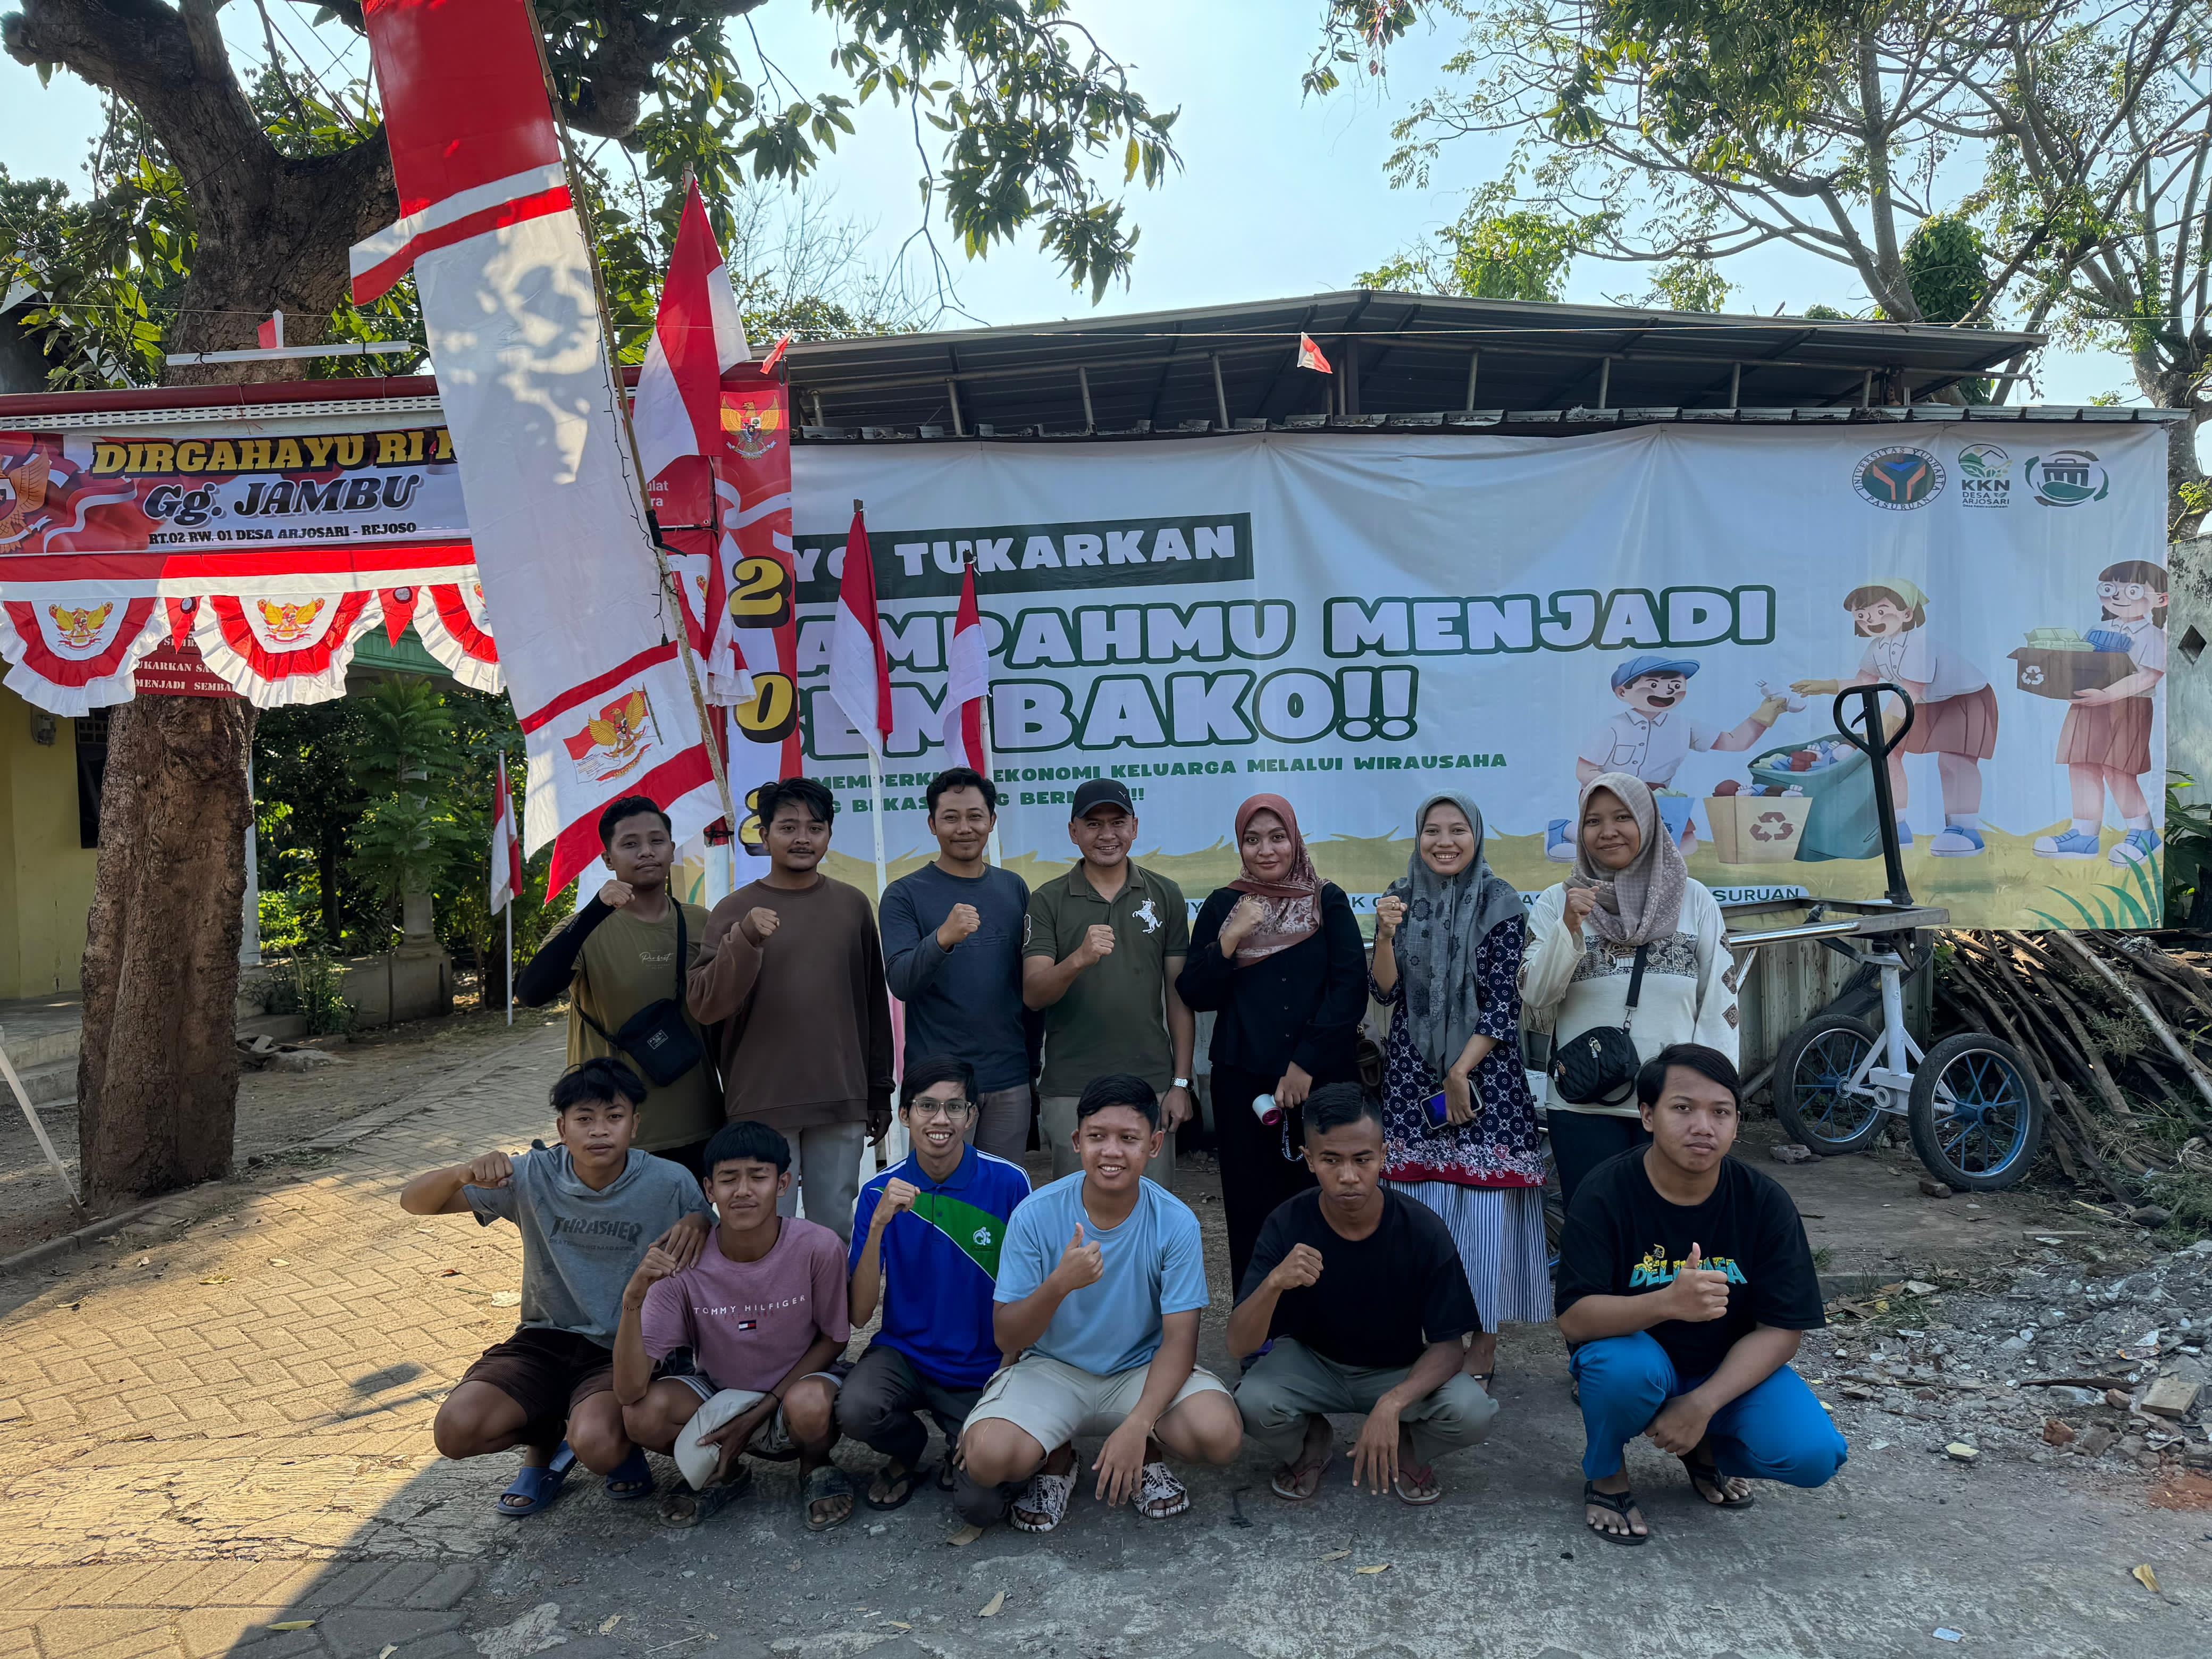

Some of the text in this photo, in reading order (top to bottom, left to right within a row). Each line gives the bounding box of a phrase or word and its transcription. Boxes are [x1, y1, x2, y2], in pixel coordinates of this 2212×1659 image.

[91, 435, 366, 475] DIRGAHAYU
[375, 430, 425, 466] RI
[1854, 447, 1945, 491] UNIVERSITAS YUDHARTA
[144, 474, 422, 527] Gg. JAMBU
[1866, 496, 1931, 511] PASURUAN
[1962, 479, 2010, 491] KKN
[148, 532, 186, 546] RT.02
[188, 530, 215, 543] RW.
[217, 530, 233, 542] 01
[235, 528, 274, 541] DESA
[277, 525, 350, 540] ARJOSARI
[361, 522, 417, 535] REJOSO
[894, 525, 1235, 576] TUKARKAN
[1323, 584, 1776, 659] MENJADI
[798, 664, 1419, 761] EMBAKO!!
[993, 766, 1101, 783] EKONOMI
[1111, 760, 1237, 778] KELUARGA
[1247, 757, 1343, 773] MELALUI
[1353, 753, 1507, 770] WIRAUSAHA
[549, 1215, 643, 1246] THRASHER
[693, 1294, 806, 1315] TOMMY HILFIGER
